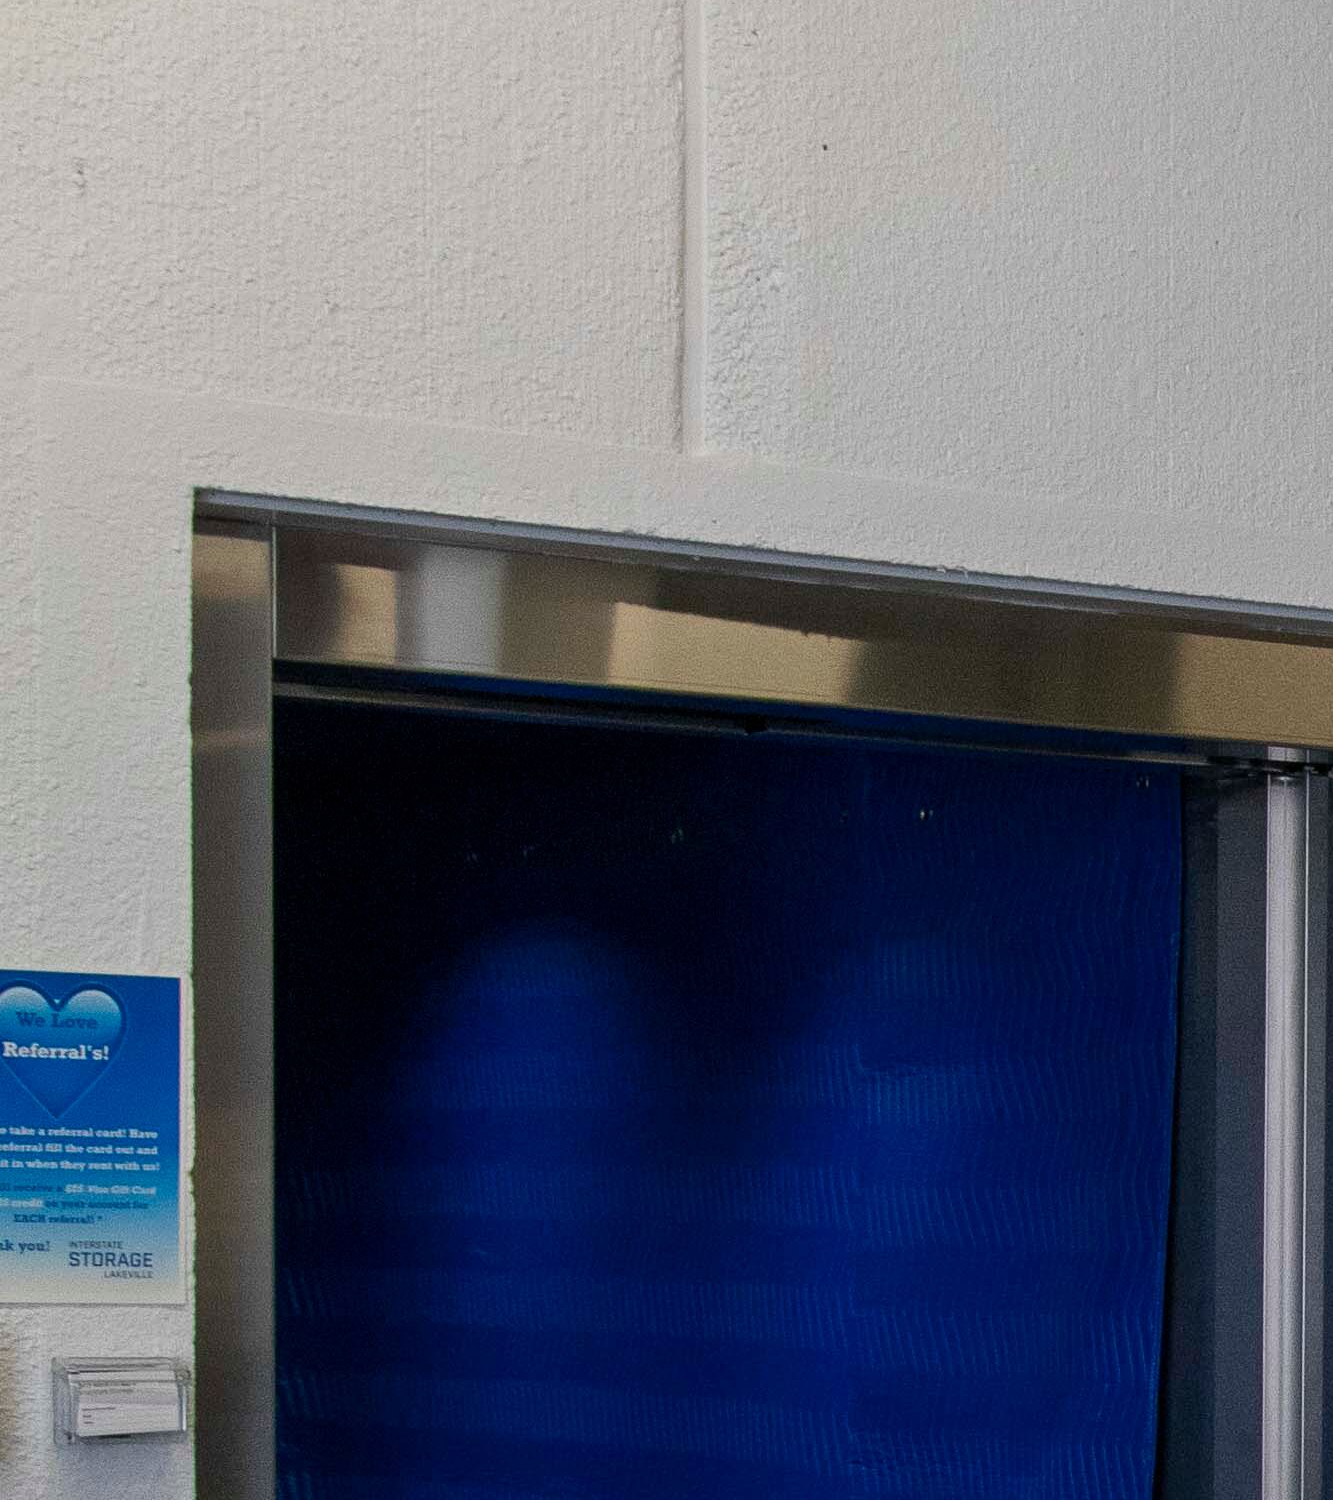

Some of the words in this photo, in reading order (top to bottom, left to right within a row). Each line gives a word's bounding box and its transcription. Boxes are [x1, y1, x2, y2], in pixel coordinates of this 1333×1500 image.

[16, 1011, 46, 1028] We
[51, 1012, 98, 1030] Love
[2, 1041, 110, 1060] Referral's!
[9, 1126, 36, 1136] take
[48, 1127, 94, 1137] referral
[129, 1128, 158, 1139] Have
[45, 1143, 62, 1152] fill
[65, 1143, 84, 1153] the
[86, 1144, 113, 1154] card
[115, 1146, 134, 1155] out
[136, 1145, 158, 1155] and
[12, 1159, 25, 1168] in
[26, 1159, 58, 1169] when
[60, 1160, 85, 1172] they
[88, 1161, 112, 1170] rent
[115, 1161, 140, 1171] with
[13, 1214, 46, 1223] EACH
[18, 1240, 50, 1254] you!
[69, 1240, 124, 1249] INTERSTATE
[69, 1252, 153, 1268] STORAGE
[104, 1270, 154, 1279] LAKEVILLE
